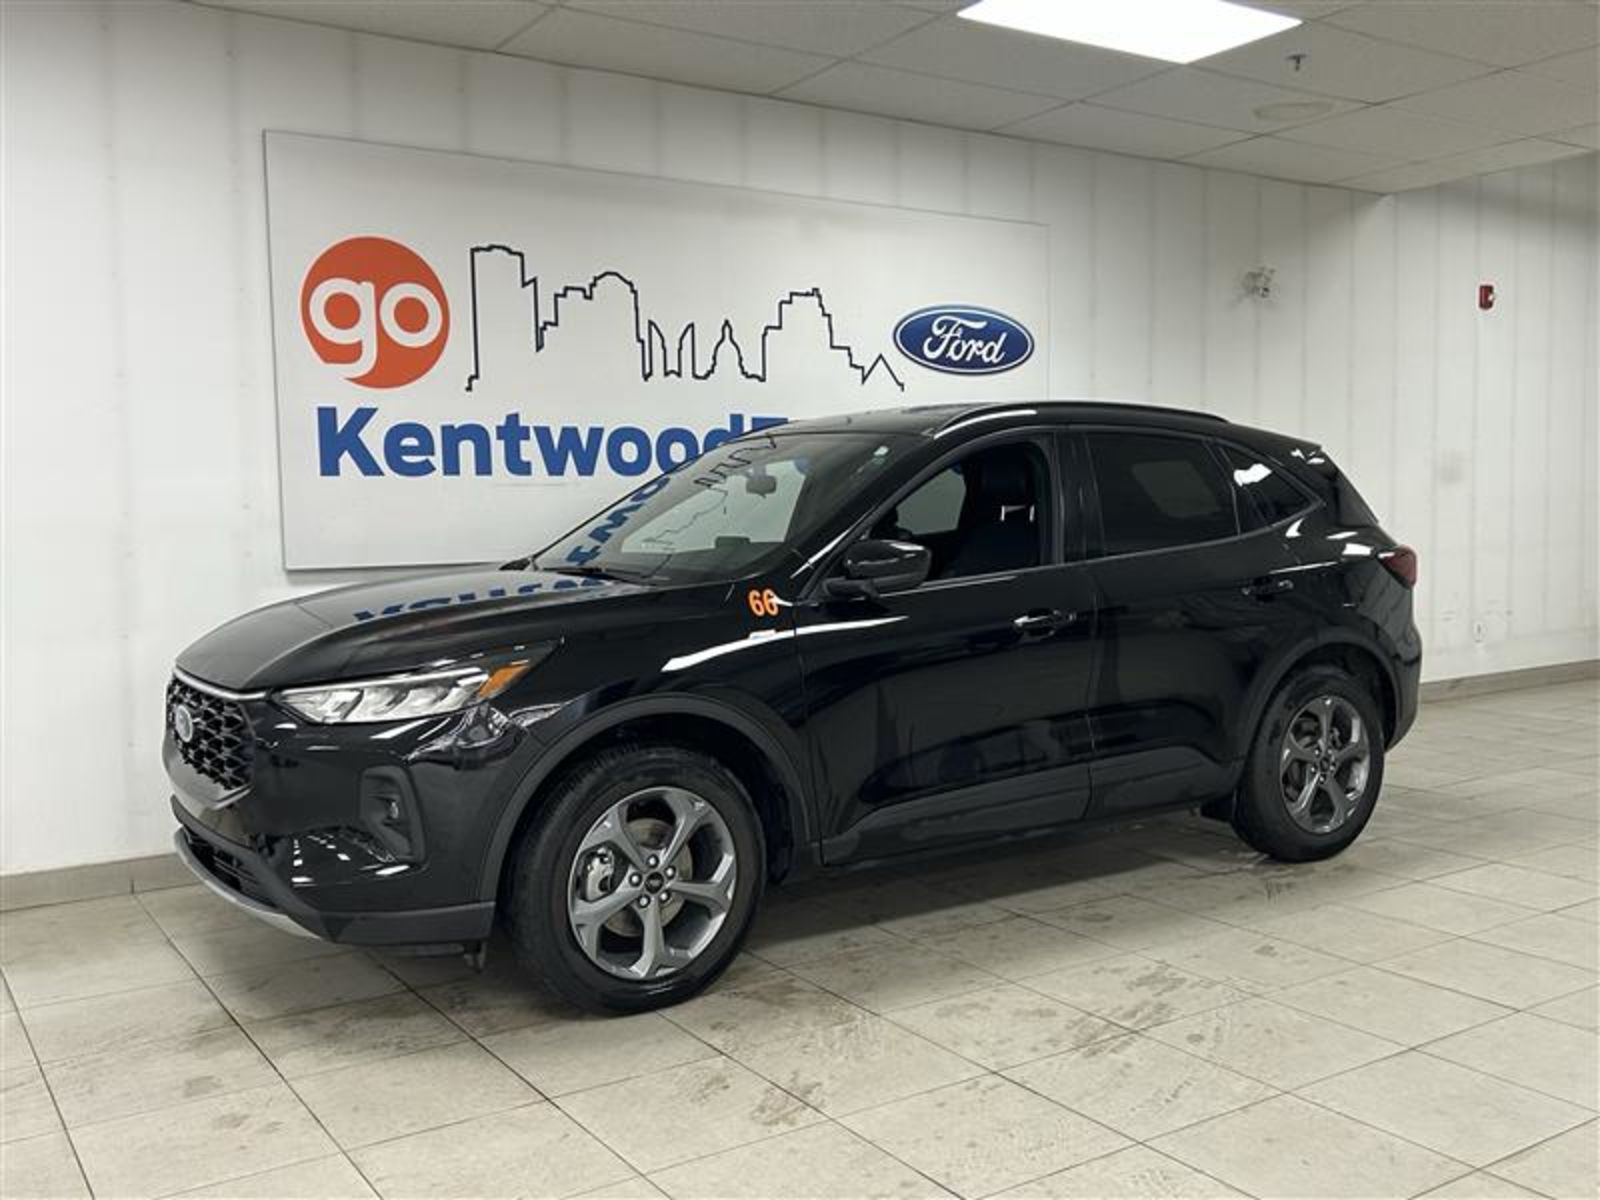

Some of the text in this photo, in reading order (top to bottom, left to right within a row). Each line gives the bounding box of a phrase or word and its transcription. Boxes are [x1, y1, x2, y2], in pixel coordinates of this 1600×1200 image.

[309, 277, 443, 378] go
[923, 315, 1008, 363] Ford
[748, 589, 779, 616] 66
